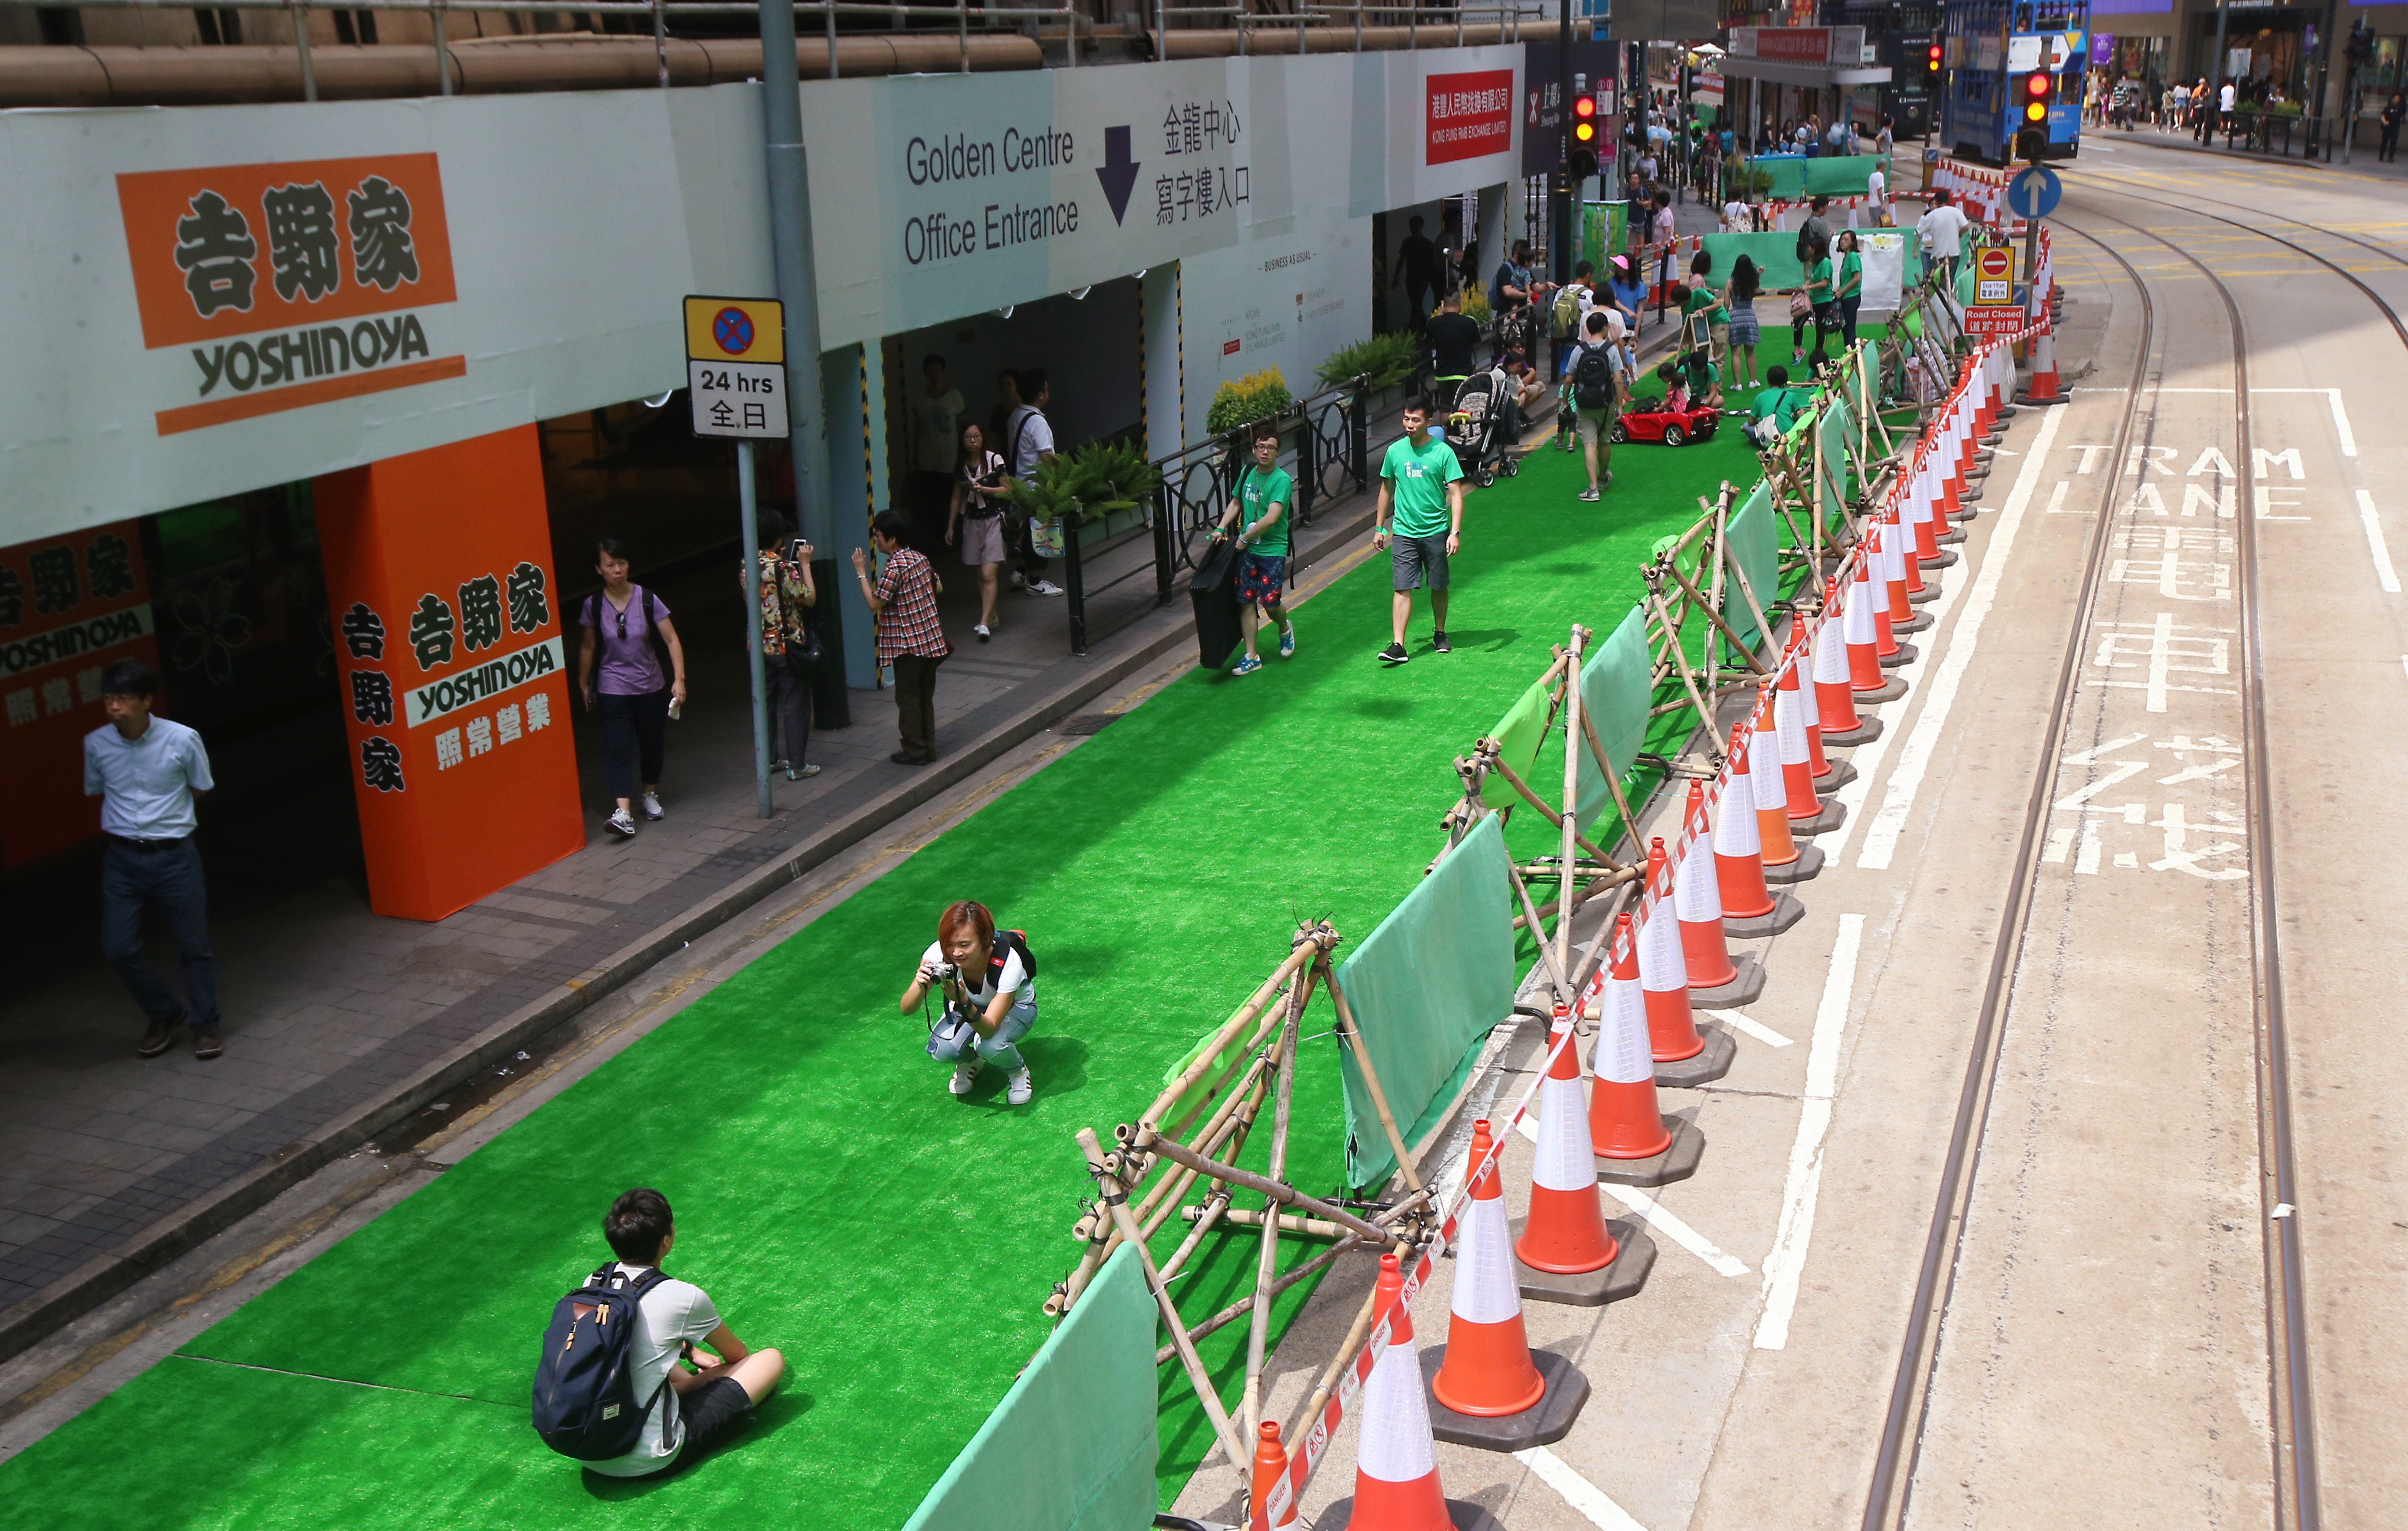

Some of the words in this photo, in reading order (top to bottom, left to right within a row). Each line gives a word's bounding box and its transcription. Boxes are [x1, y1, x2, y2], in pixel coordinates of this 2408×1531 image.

[1162, 100, 1241, 155] 金龍中心
[1432, 130, 1445, 144] KONG
[1446, 127, 1458, 142] FUNG
[1458, 126, 1467, 140] RMB
[1468, 123, 1491, 138] EXCHANGE
[1491, 120, 1506, 134] LIMITED
[907, 133, 996, 186] Golden
[1003, 125, 1074, 173] Centre
[1155, 166, 1250, 226] 寫字樓入口
[173, 175, 420, 318] 吉野家
[904, 213, 976, 265] Office
[985, 200, 1078, 250] Entrance
[1265, 256, 1288, 272] BUSINESS
[1289, 254, 1296, 265] AS
[1296, 250, 1311, 263] USUAL
[1967, 310, 1989, 318] Road
[1992, 309, 2022, 318] Closed
[1981, 289, 2005, 297] 電車例外
[1969, 320, 2019, 331] 道路封閉
[192, 313, 430, 397] YOSHINOYA
[701, 369, 730, 391] 24
[737, 372, 772, 394] hrs
[710, 400, 765, 429] 全日
[2067, 445, 2306, 480] TRAM
[2047, 481, 2311, 520] LANE
[0, 610, 142, 673] OSHINOYA
[409, 561, 550, 671] 吉野家
[5, 663, 107, 727] 照常營
[341, 602, 406, 793] 吉野家
[417, 644, 555, 719] YOSHINOYA
[435, 693, 551, 771] 照常營業
[1371, 1323, 1387, 1349] DANGER
[1268, 1483, 1287, 1514] DANGER
